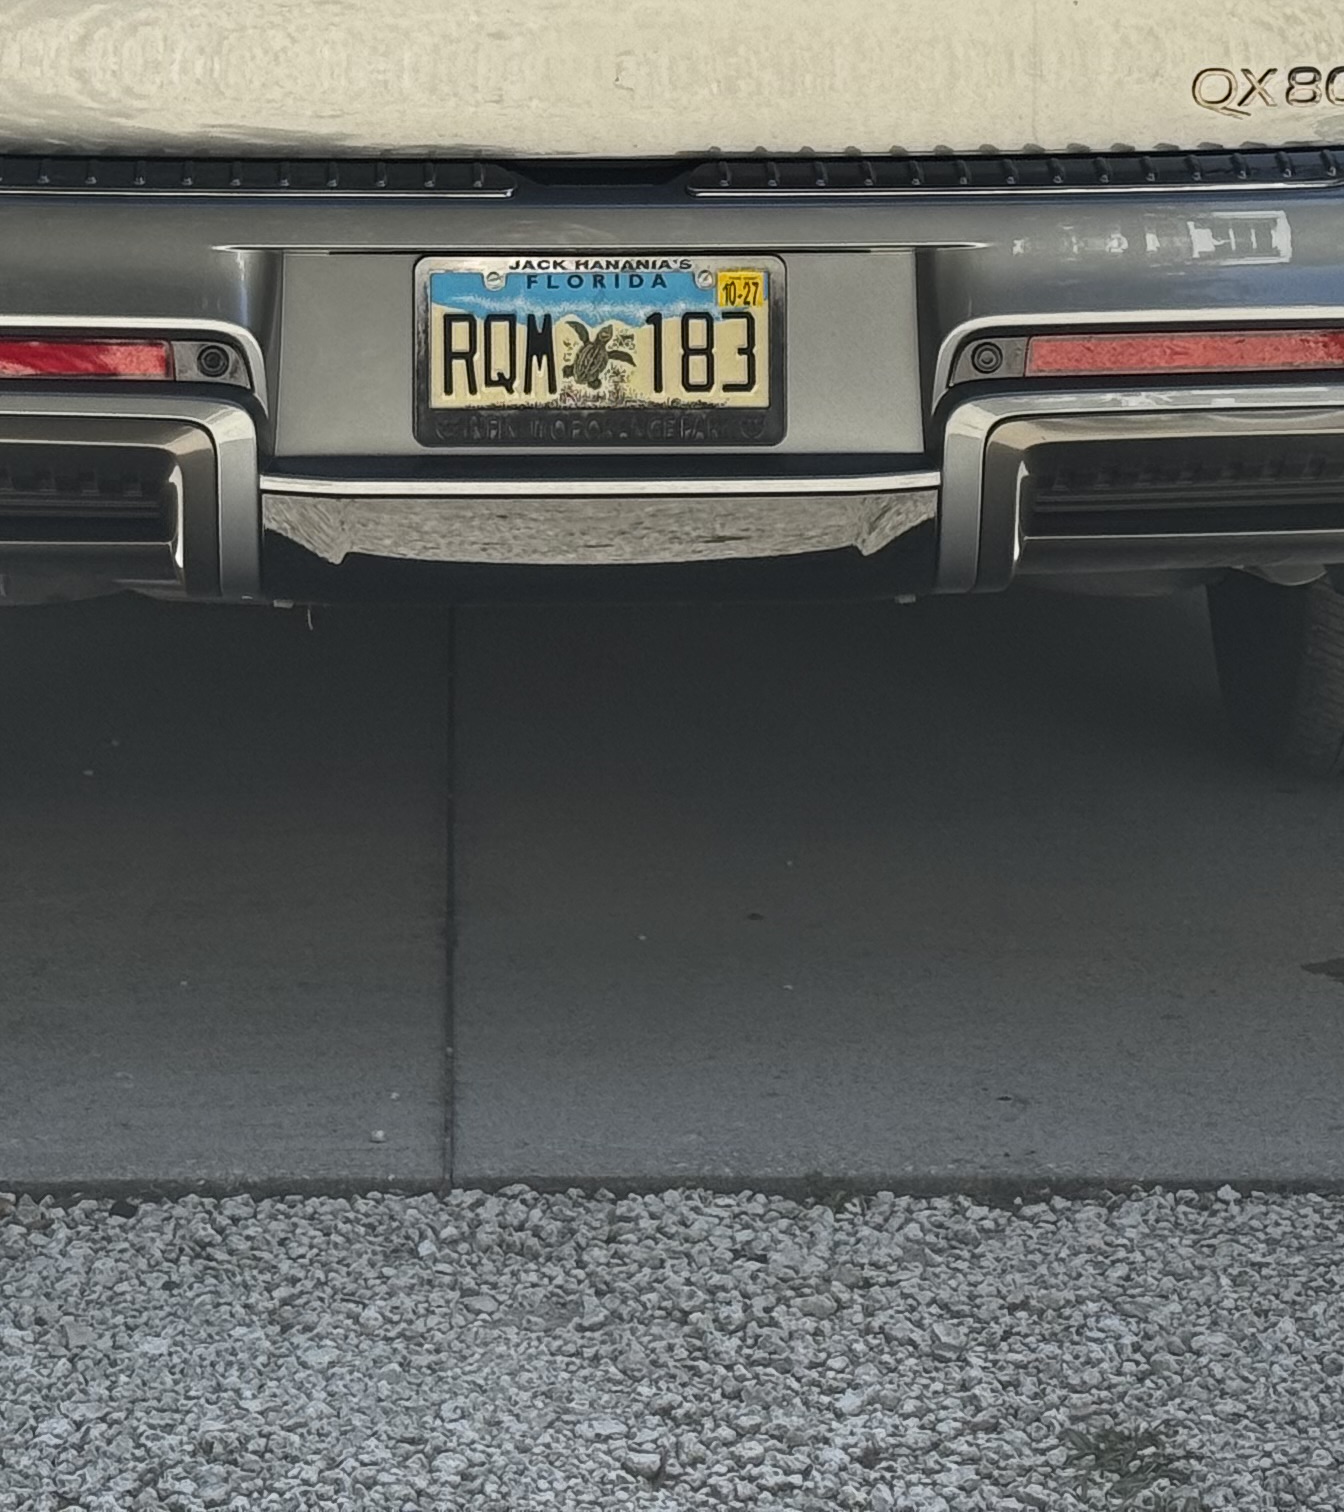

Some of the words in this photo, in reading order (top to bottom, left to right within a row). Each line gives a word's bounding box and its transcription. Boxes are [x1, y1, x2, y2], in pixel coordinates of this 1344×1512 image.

[508, 259, 568, 271] JACK
[574, 259, 693, 271] HANANIA'S
[526, 274, 668, 289] FLORIDA
[443, 313, 556, 396] RQM
[645, 311, 757, 394] 183
